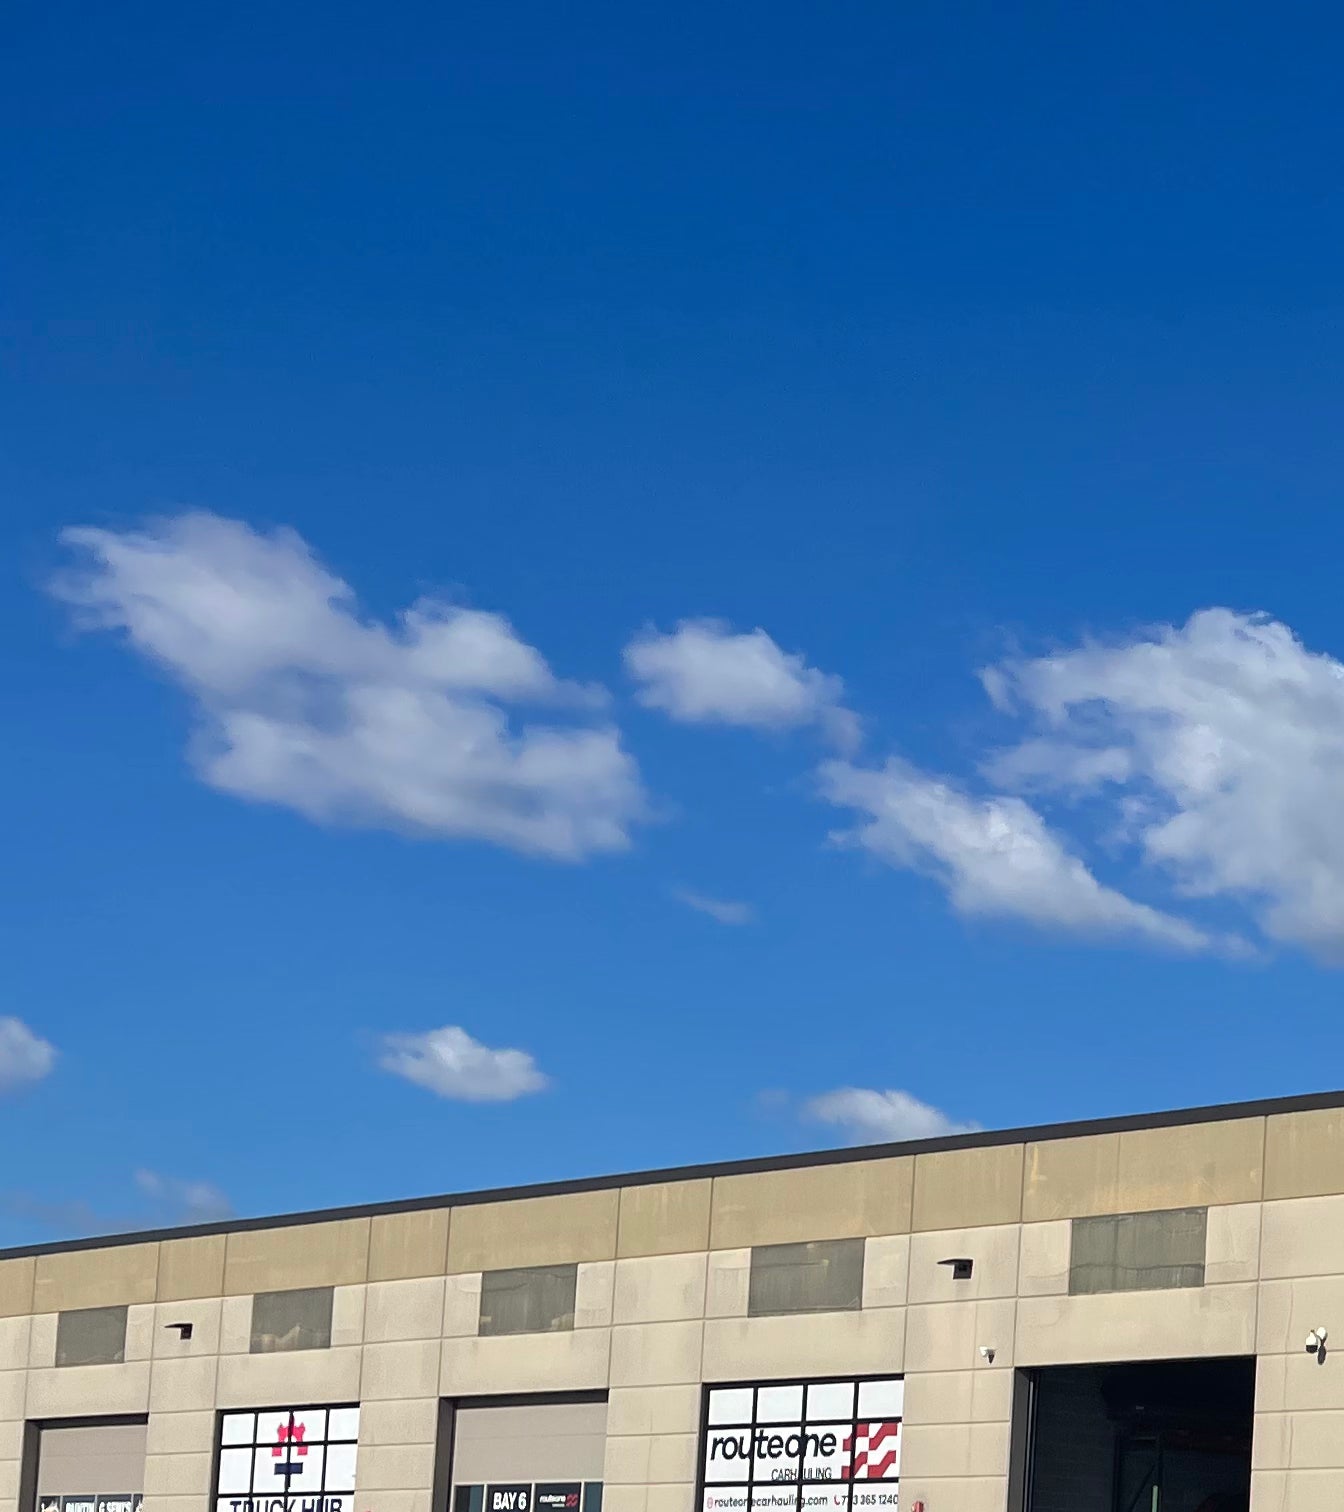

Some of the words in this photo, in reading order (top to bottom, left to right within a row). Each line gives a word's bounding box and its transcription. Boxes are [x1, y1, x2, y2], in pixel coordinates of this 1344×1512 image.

[710, 1430, 837, 1460] routeone
[771, 1466, 833, 1481] CARHULING
[493, 1491, 517, 1510] BAY
[518, 1491, 527, 1510] 6
